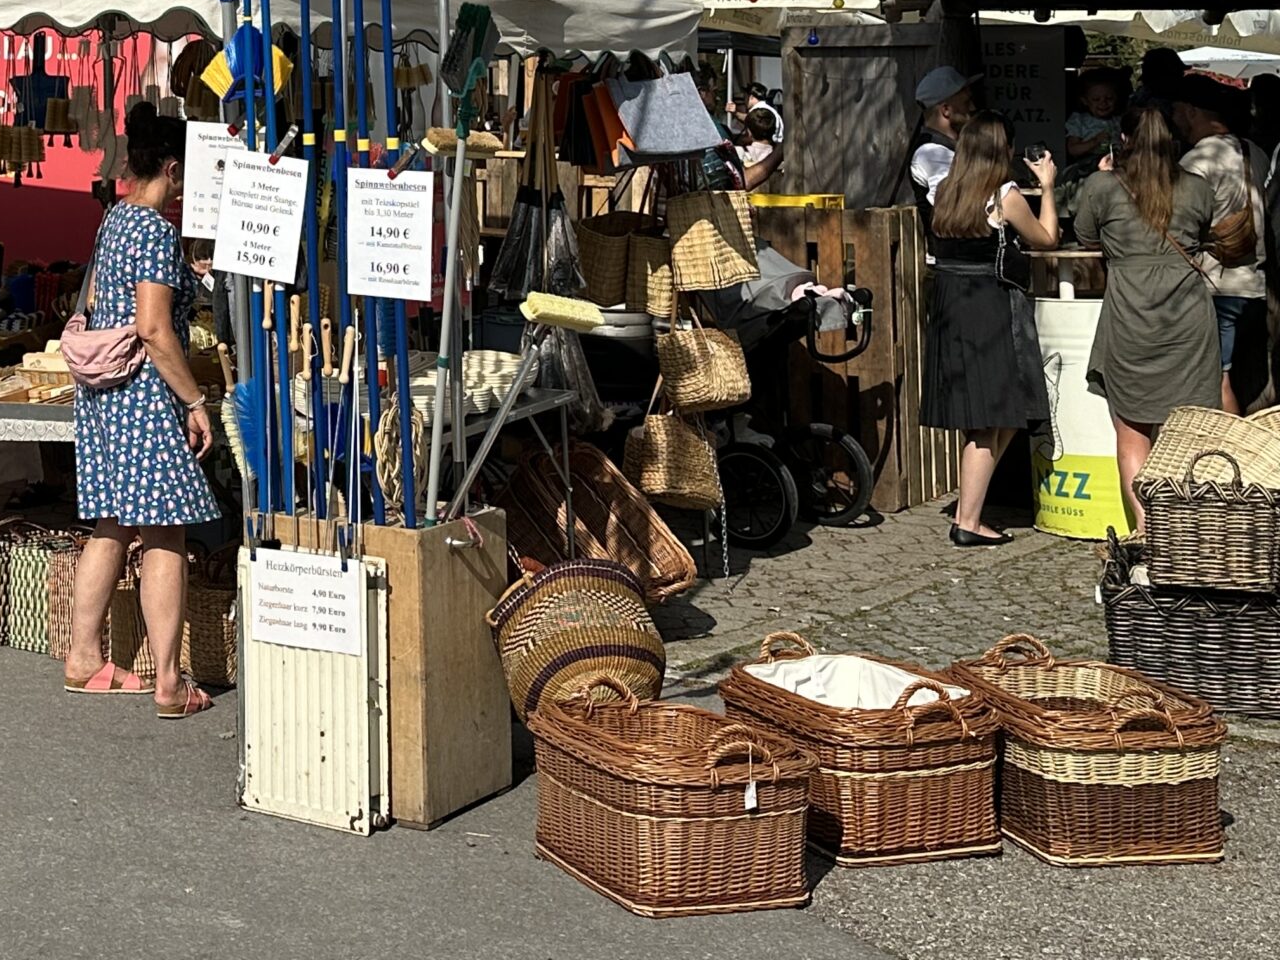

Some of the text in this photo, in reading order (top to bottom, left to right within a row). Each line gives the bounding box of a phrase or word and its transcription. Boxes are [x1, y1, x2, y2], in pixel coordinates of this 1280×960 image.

[981, 42, 1016, 56] LES
[994, 82, 1032, 101] FÜR
[233, 159, 302, 178] Spinnwebenbesen
[258, 182, 280, 193] Meter
[355, 180, 427, 191] Spinnwebenbesen
[229, 188, 259, 199] komplett
[260, 194, 272, 202] mit
[270, 205, 294, 216] Gelenk
[364, 208, 374, 216] bis
[393, 209, 413, 218] Meter
[241, 220, 280, 236] 10,90 €
[370, 226, 410, 239] 14,90 €
[250, 241, 271, 251] Meter
[237, 251, 276, 267] 15,90 €
[370, 262, 410, 275] 16,90 €
[1041, 469, 1091, 500] NZZ
[1061, 506, 1084, 517] SÜSS
[266, 560, 343, 578] Heizkörperbürsten
[312, 589, 345, 600] 4,90 Euro
[294, 603, 308, 612] kurz
[312, 605, 345, 617] 7,90 Euro
[294, 620, 307, 631] lang
[312, 622, 346, 634] 9,90 Euro
